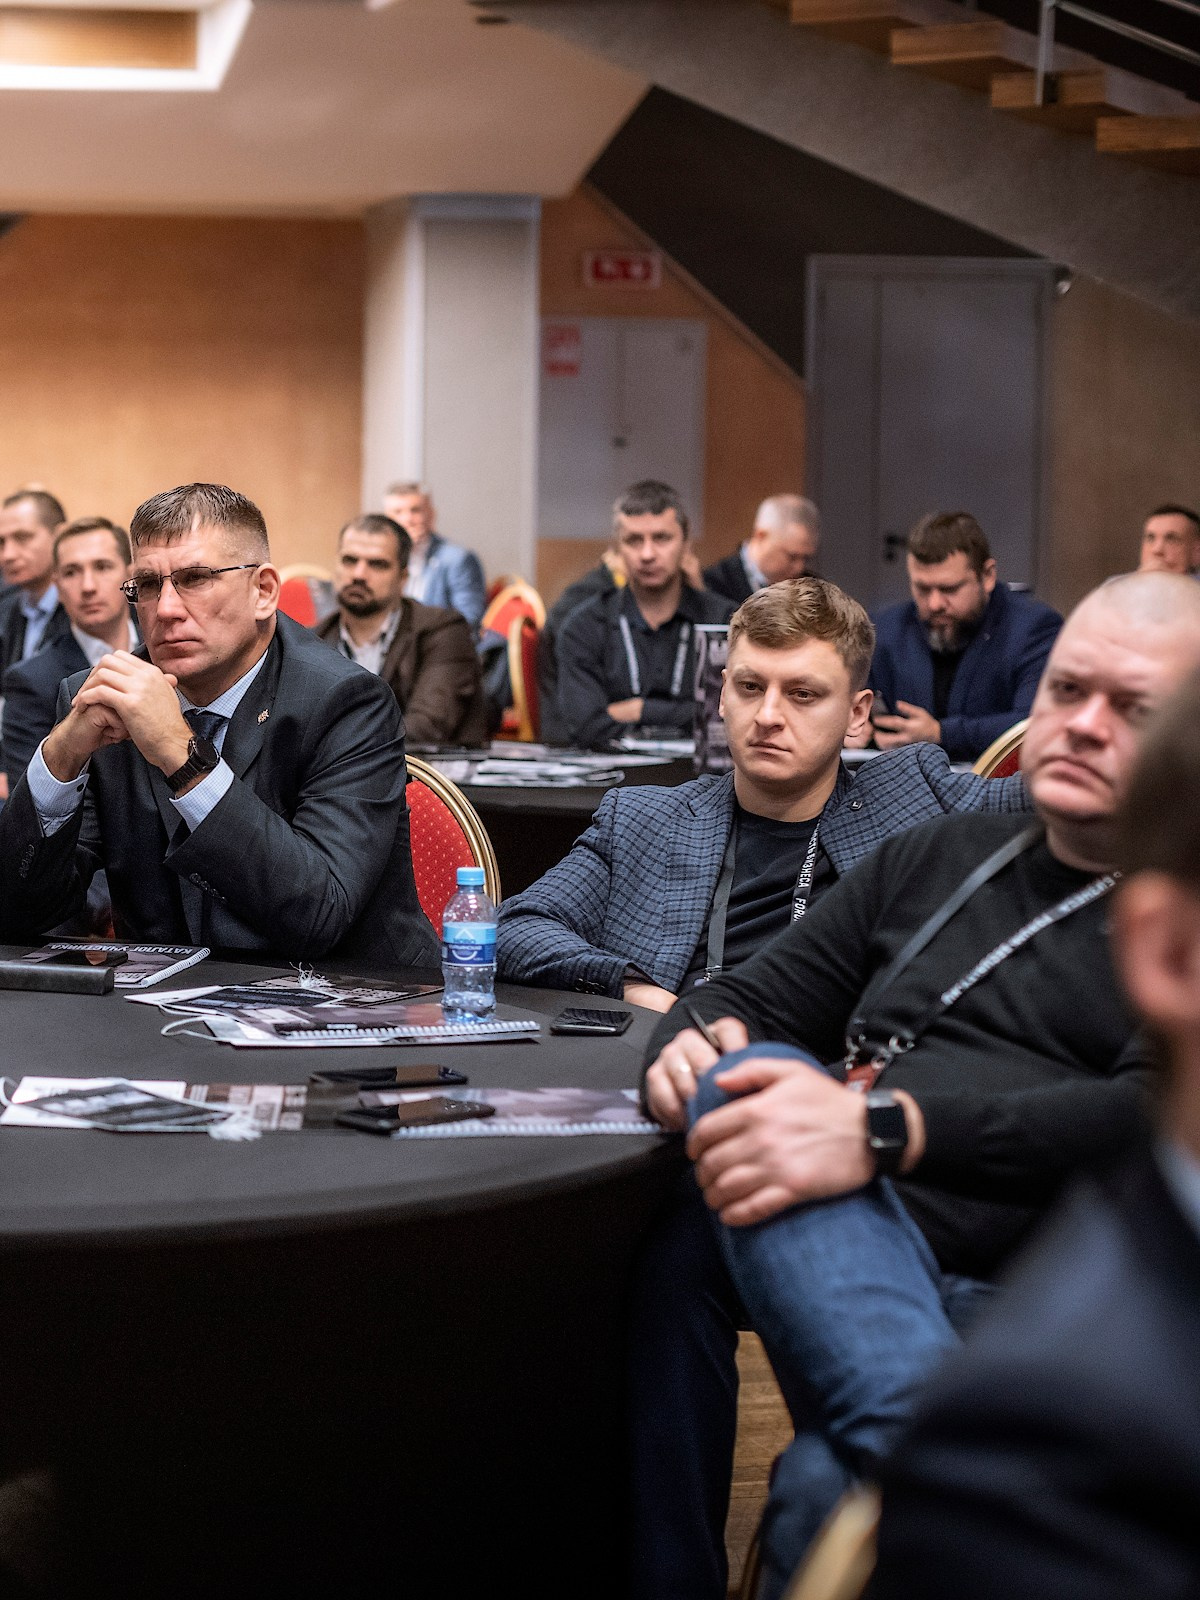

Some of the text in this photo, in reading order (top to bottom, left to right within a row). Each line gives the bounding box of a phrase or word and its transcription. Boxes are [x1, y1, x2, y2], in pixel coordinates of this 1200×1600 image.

[793, 897, 807, 922] FORU
[50, 943, 193, 955] КАТАЛОГ УЧАСТНИКА
